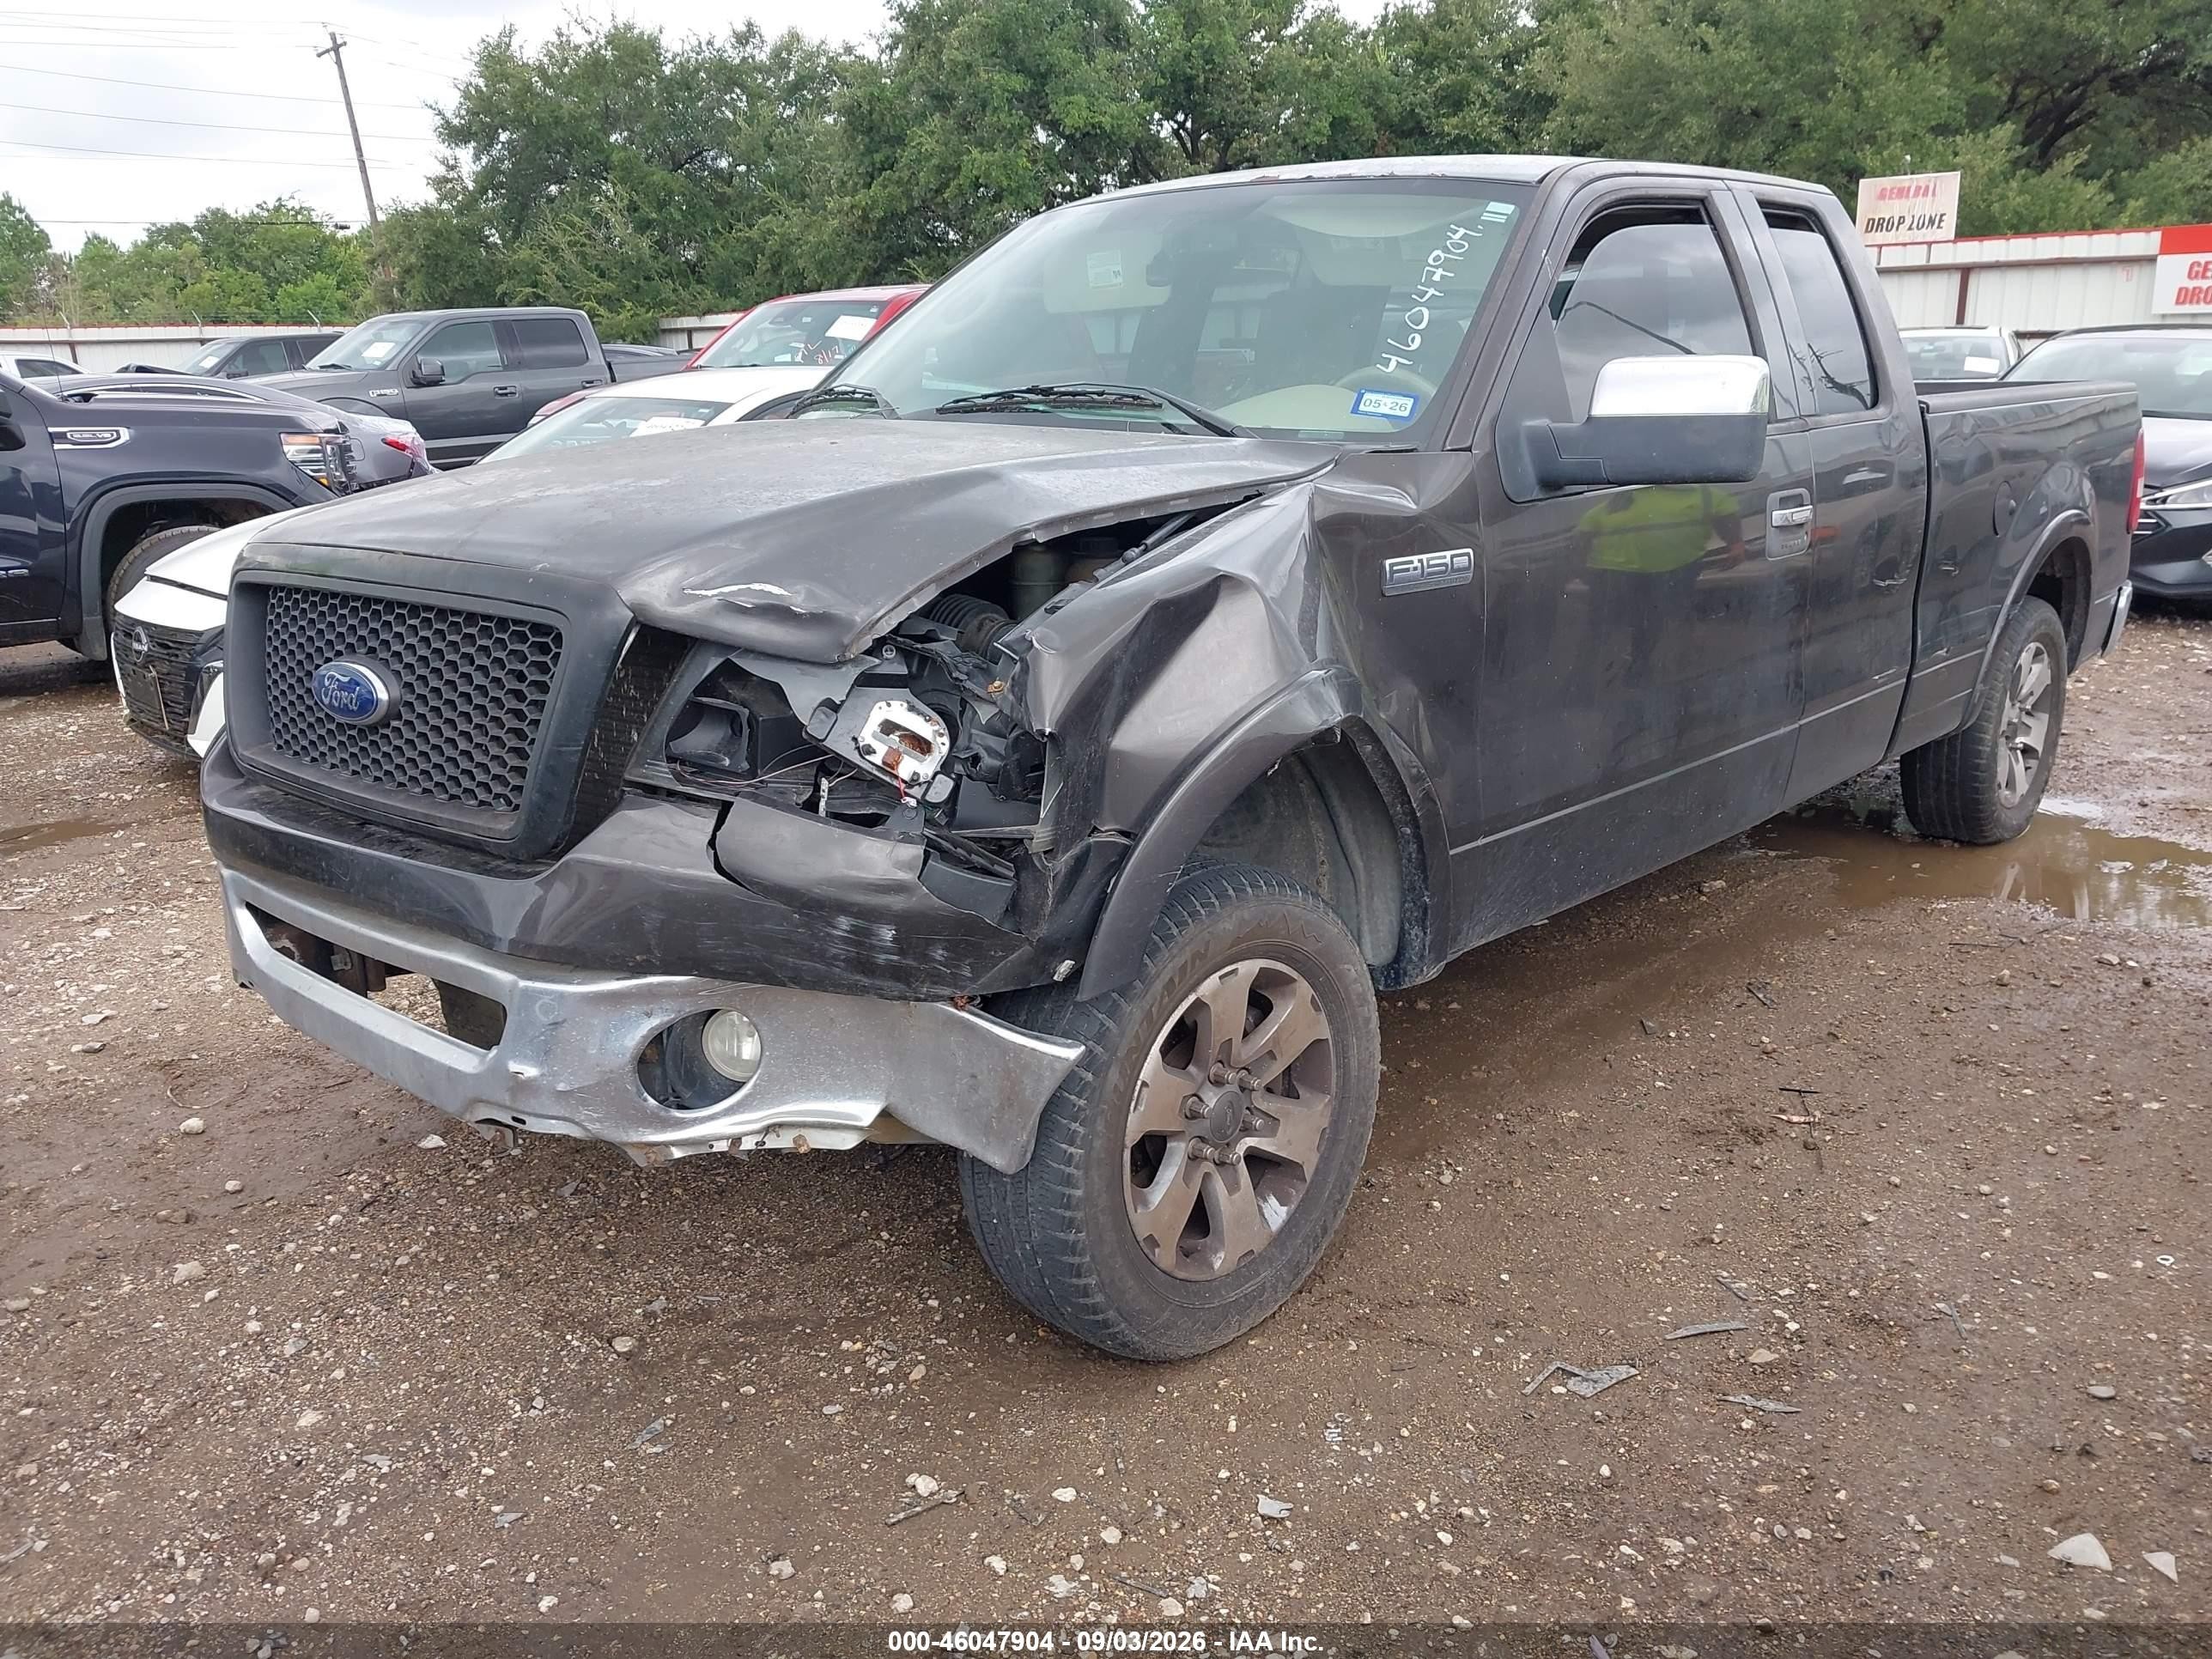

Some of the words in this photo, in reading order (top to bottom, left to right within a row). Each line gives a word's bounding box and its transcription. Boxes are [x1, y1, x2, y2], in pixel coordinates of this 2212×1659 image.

[1863, 215, 1906, 234] DROP
[1906, 212, 1948, 231] ZONE
[1363, 398, 1384, 410] 05
[1388, 401, 1409, 414] 26
[321, 672, 361, 712] Ford
